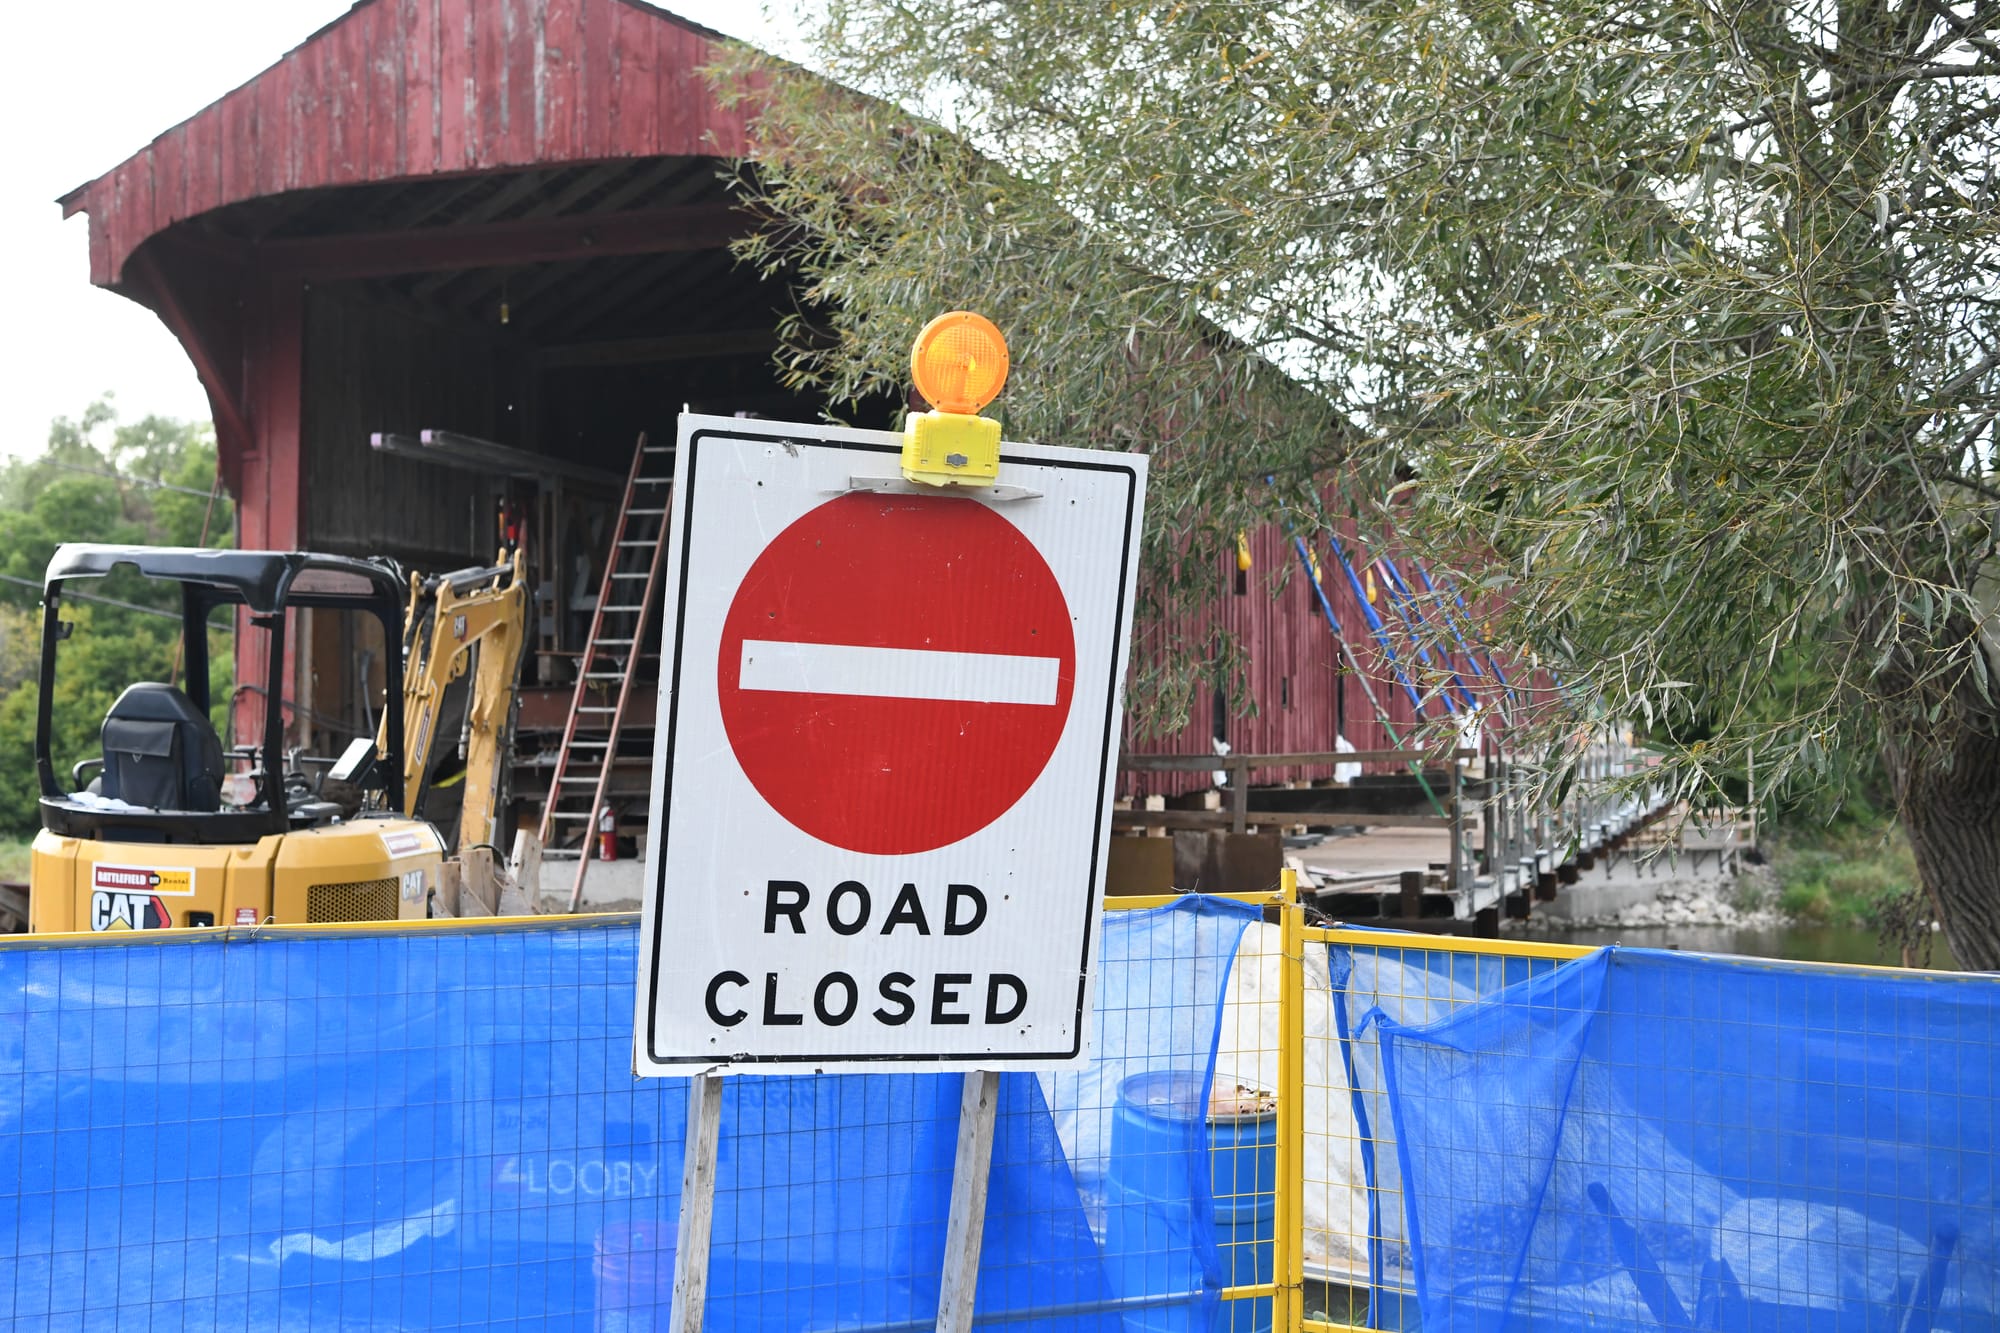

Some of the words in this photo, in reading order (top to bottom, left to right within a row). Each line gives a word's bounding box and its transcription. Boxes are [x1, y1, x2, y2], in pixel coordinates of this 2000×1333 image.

[97, 871, 147, 886] BATTLEFIELD
[163, 877, 189, 885] Rental
[403, 870, 423, 899] CAT
[92, 890, 151, 931] CAT
[763, 880, 988, 936] ROAD
[704, 970, 1028, 1026] CLOSED
[527, 1158, 660, 1197] LOOBY
